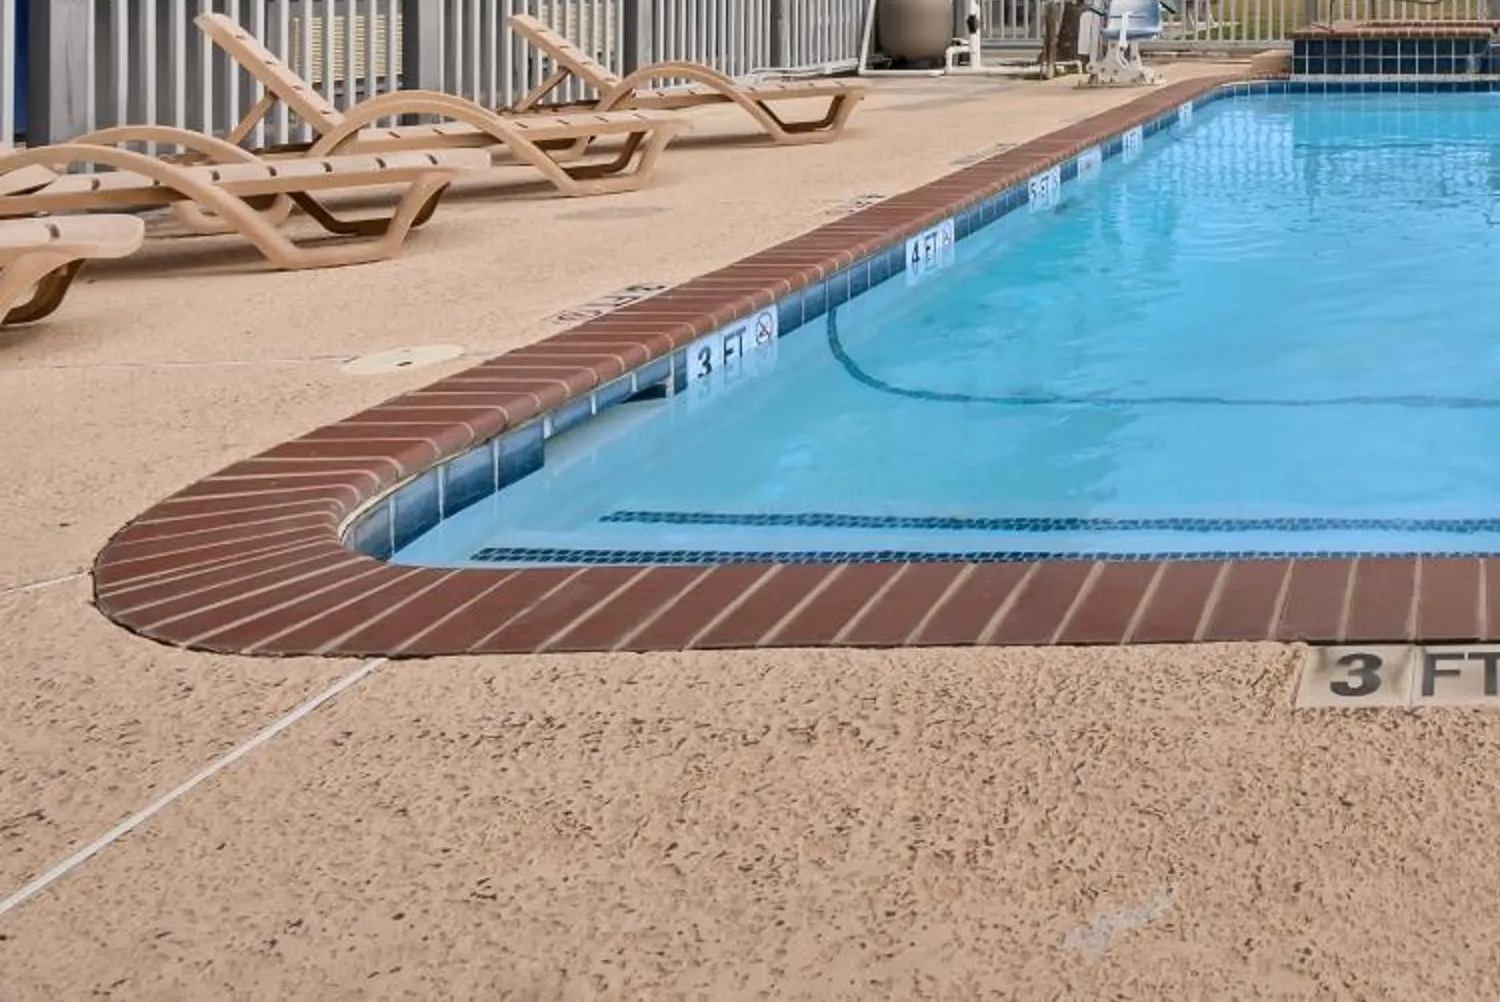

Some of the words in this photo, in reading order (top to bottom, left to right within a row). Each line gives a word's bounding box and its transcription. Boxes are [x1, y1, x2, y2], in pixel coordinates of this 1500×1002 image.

[911, 240, 920, 263] 4
[925, 232, 938, 262] FT
[697, 345, 712, 379] 3
[723, 325, 746, 367] FT
[1329, 653, 1384, 697] 3
